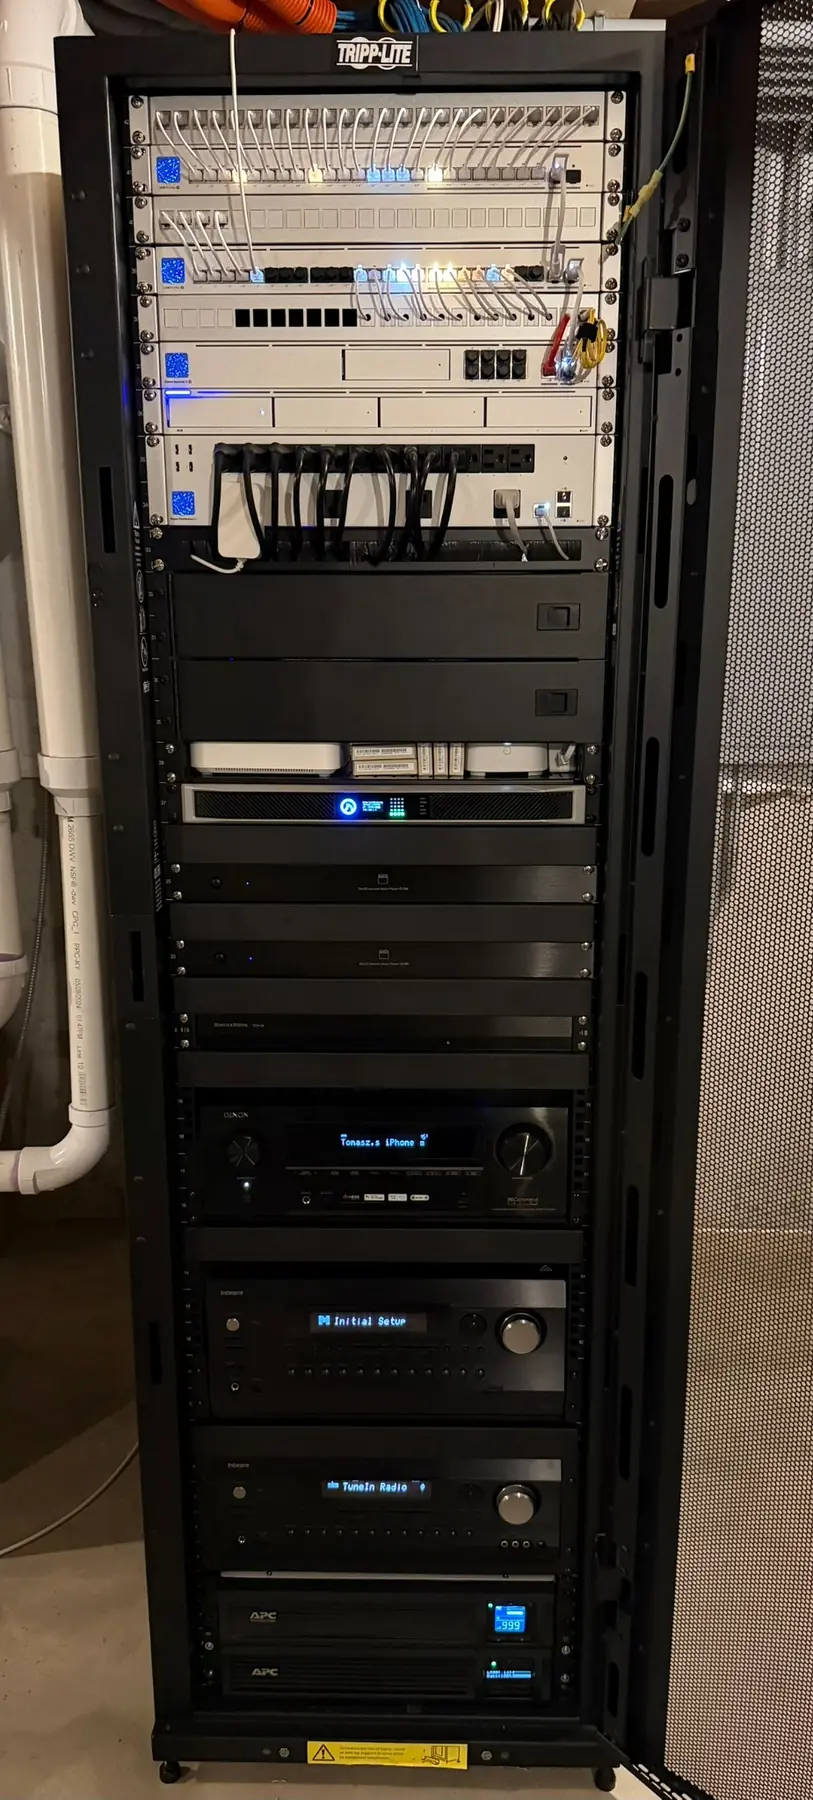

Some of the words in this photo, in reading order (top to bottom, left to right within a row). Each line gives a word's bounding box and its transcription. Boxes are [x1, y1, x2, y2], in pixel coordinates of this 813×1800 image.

[67, 824, 75, 842] 2665
[68, 843, 76, 862] DWV
[386, 1138, 415, 1147] iPhone
[334, 1316, 372, 1326] Initial
[378, 1316, 406, 1327] Setup
[343, 1482, 375, 1492] TuneIn
[380, 1482, 407, 1492] Radio
[249, 1611, 277, 1620] APC
[502, 1621, 520, 1630] 999
[251, 1667, 279, 1676] APC
